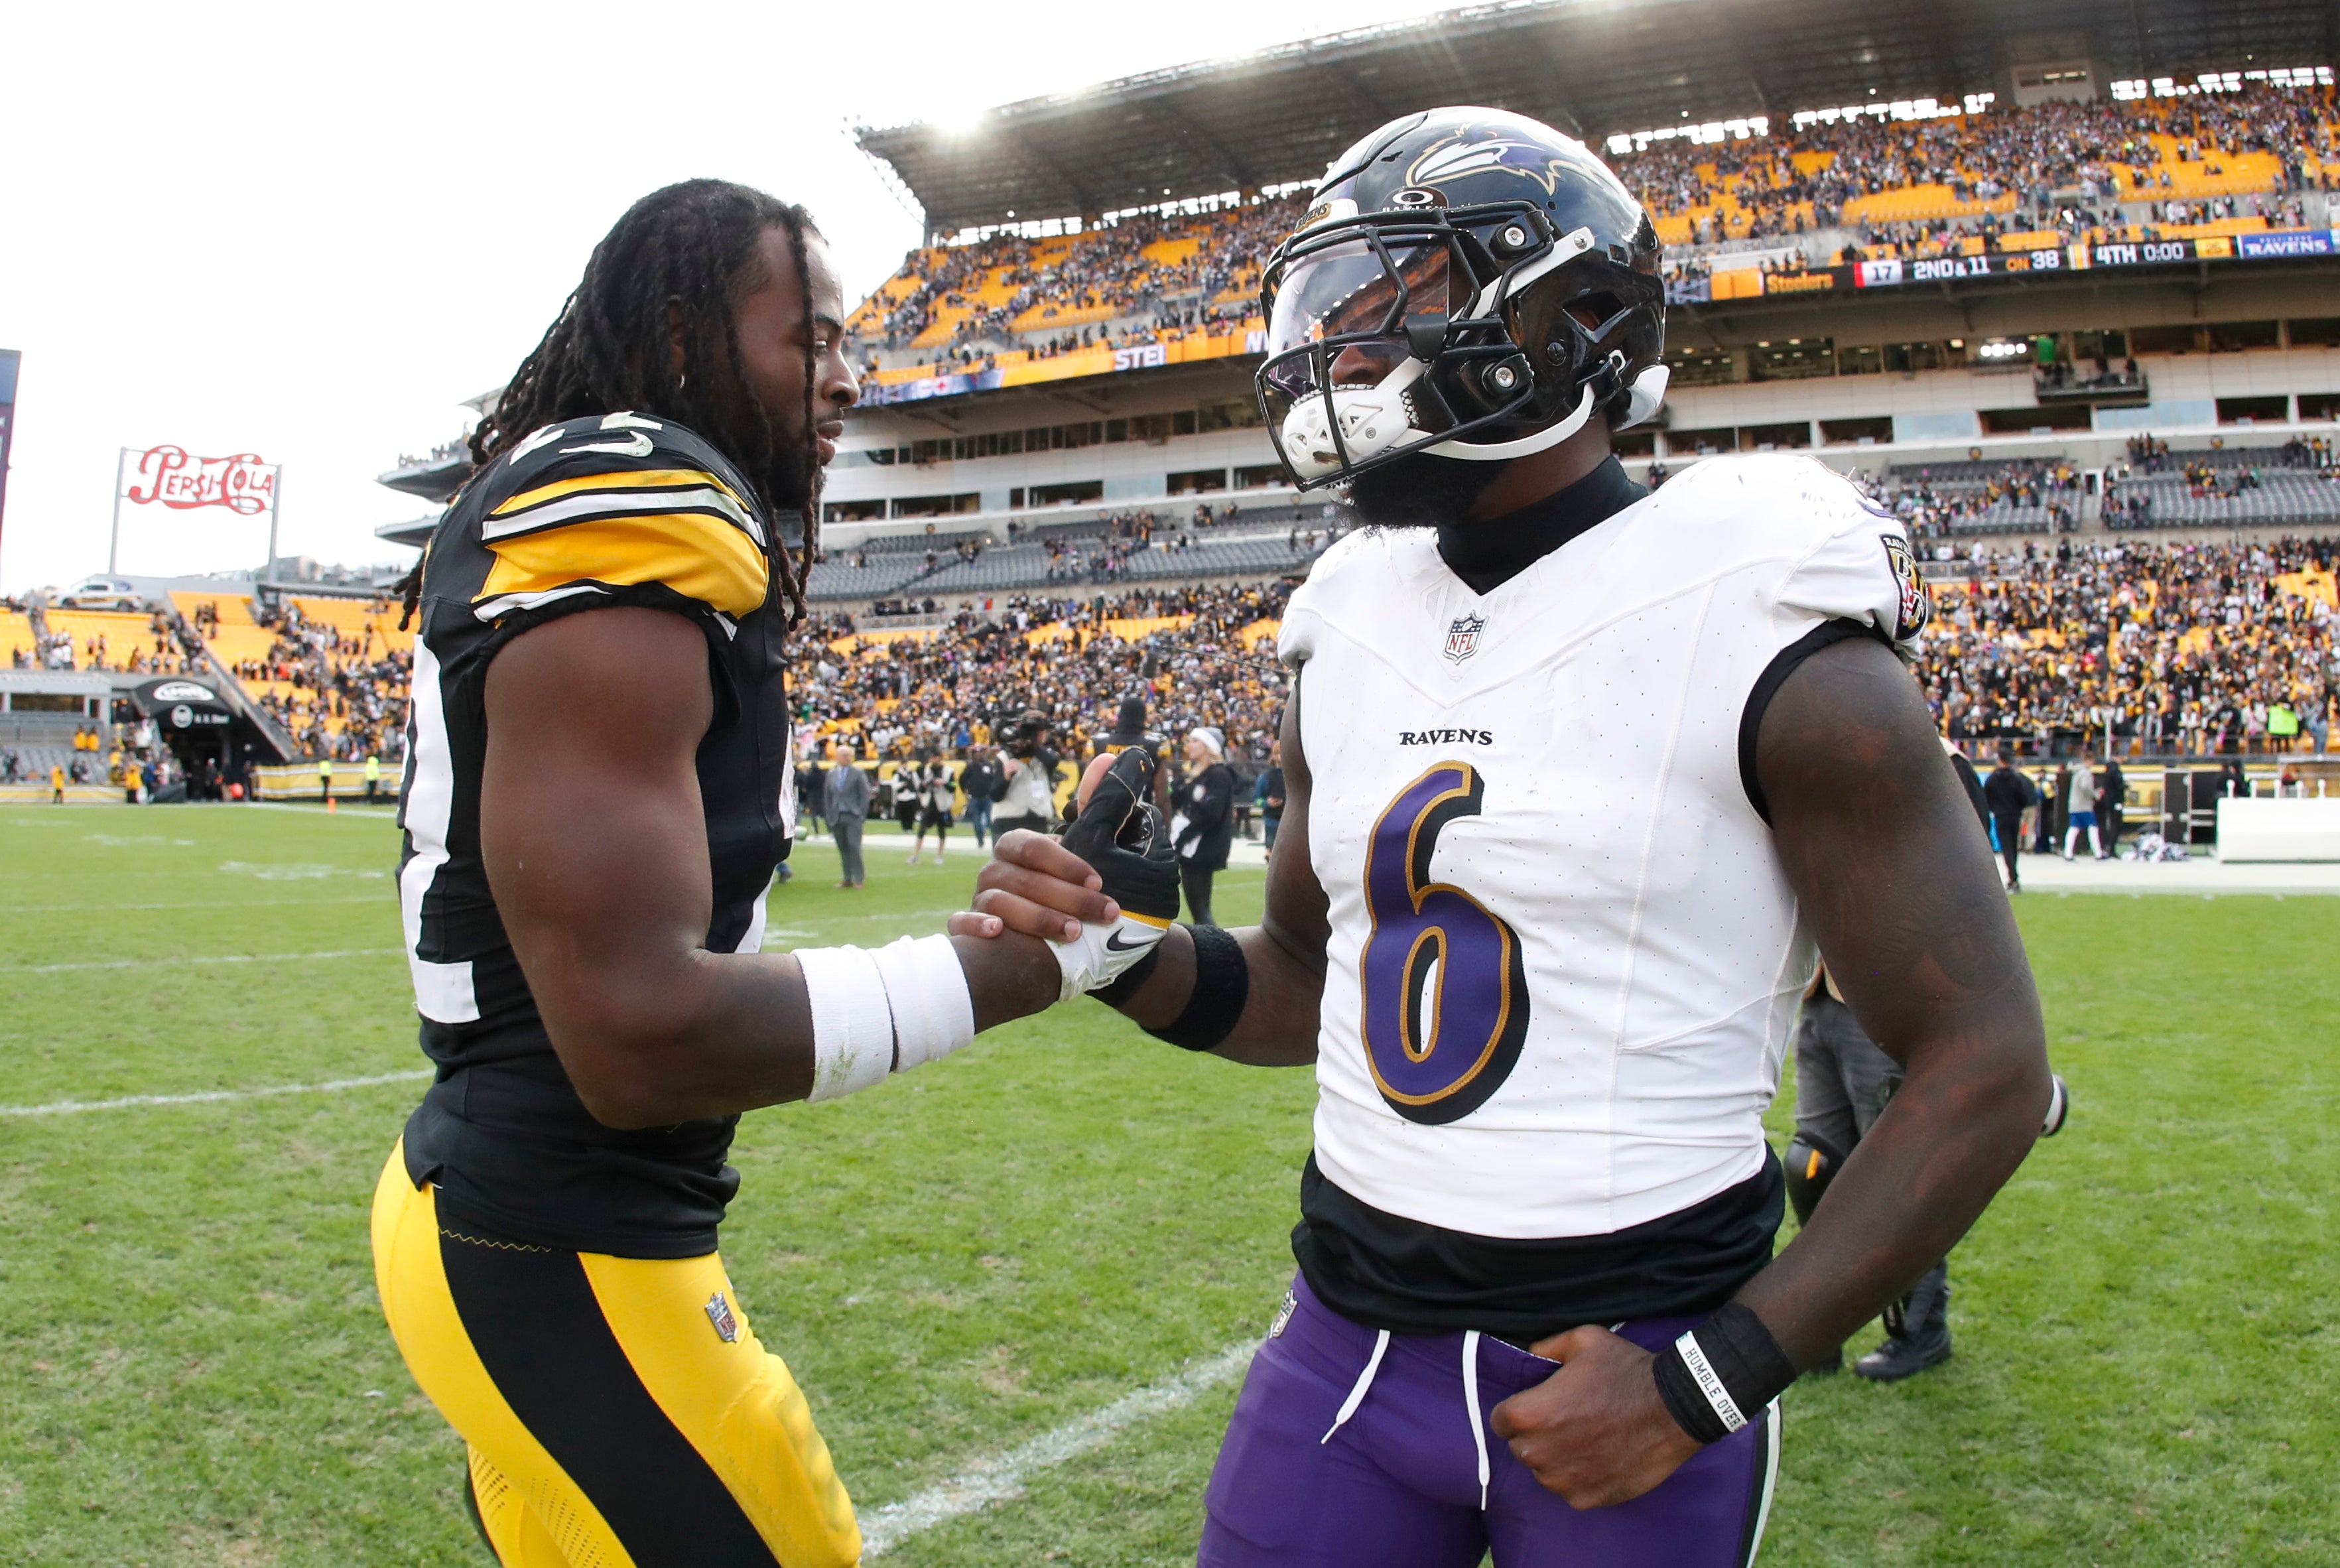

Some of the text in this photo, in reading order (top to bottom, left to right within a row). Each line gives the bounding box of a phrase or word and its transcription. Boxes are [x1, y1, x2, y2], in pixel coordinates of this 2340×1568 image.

[2096, 241, 2185, 264] 4TH 0:00
[2245, 239, 2327, 256] RAVENS
[1873, 265, 1894, 281] 17
[1913, 258, 1955, 280] 2ND
[1967, 255, 1991, 275] 11
[2030, 249, 2060, 270] 38
[1448, 633, 1473, 653] NFL
[1399, 728, 1493, 746] RAVENS
[1360, 760, 1530, 1126] 6
[1685, 1348, 1721, 1398] HUMBLE
[1717, 1399, 1741, 1427] OVER
